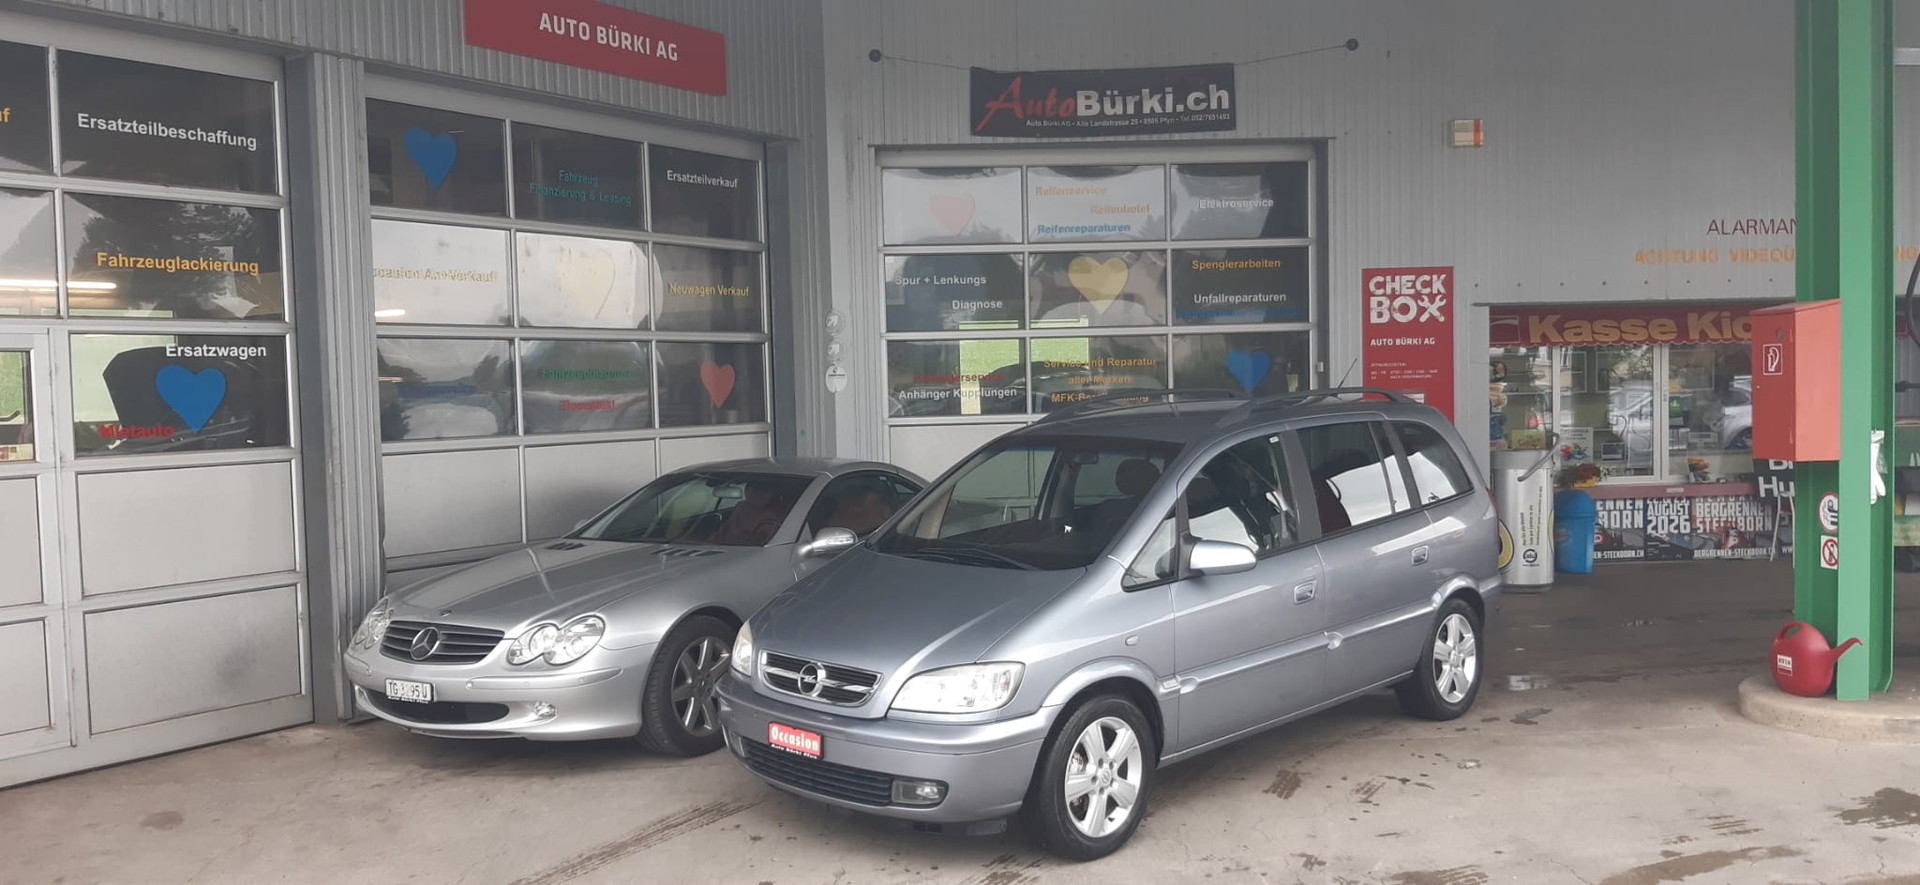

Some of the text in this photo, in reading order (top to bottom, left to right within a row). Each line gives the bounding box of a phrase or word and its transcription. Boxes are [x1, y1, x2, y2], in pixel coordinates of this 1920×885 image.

[539, 12, 679, 61] AUTO BÜRKI AG
[975, 74, 1230, 132] AutoBürki.ch
[77, 112, 257, 151] Ersatzteilbeschaffung
[1061, 120, 1071, 128] AG
[559, 169, 599, 187] Fahrzeug
[666, 170, 738, 189] Ersatzteilverkauf
[529, 182, 585, 201] Finanzierung
[600, 190, 631, 207] Leasing
[1199, 198, 1274, 209] Elektroservice
[1037, 223, 1131, 235] Reifenreparaturen
[96, 251, 259, 276] Fahrzeuglackierung
[1635, 248, 1719, 265] ACHTUNG
[1192, 259, 1281, 271] Spenglerarbeiten
[895, 274, 987, 287] Spur + Lenkungs
[1369, 274, 1446, 295] CHECK
[669, 281, 750, 298] Neuwagen Verkauf
[952, 298, 1003, 311] Diagnose
[1194, 292, 1287, 305] Unfallreparaturen
[1370, 295, 1446, 324] BOX
[1529, 315, 1678, 343] Kasse
[1370, 336, 1436, 346] AUTO BÜRKI AG
[165, 343, 267, 359] Ersatzwagen
[1043, 357, 1156, 368] Service und Reparatur
[899, 388, 1017, 401] Anhänger Kupplungen
[98, 423, 176, 439] Mietauto
[1647, 503, 1689, 516] AUGUST
[1696, 502, 1772, 517] BERGRENNEN
[1647, 516, 1690, 535] 2026
[388, 681, 398, 695] TG
[771, 726, 819, 752] Occasion
